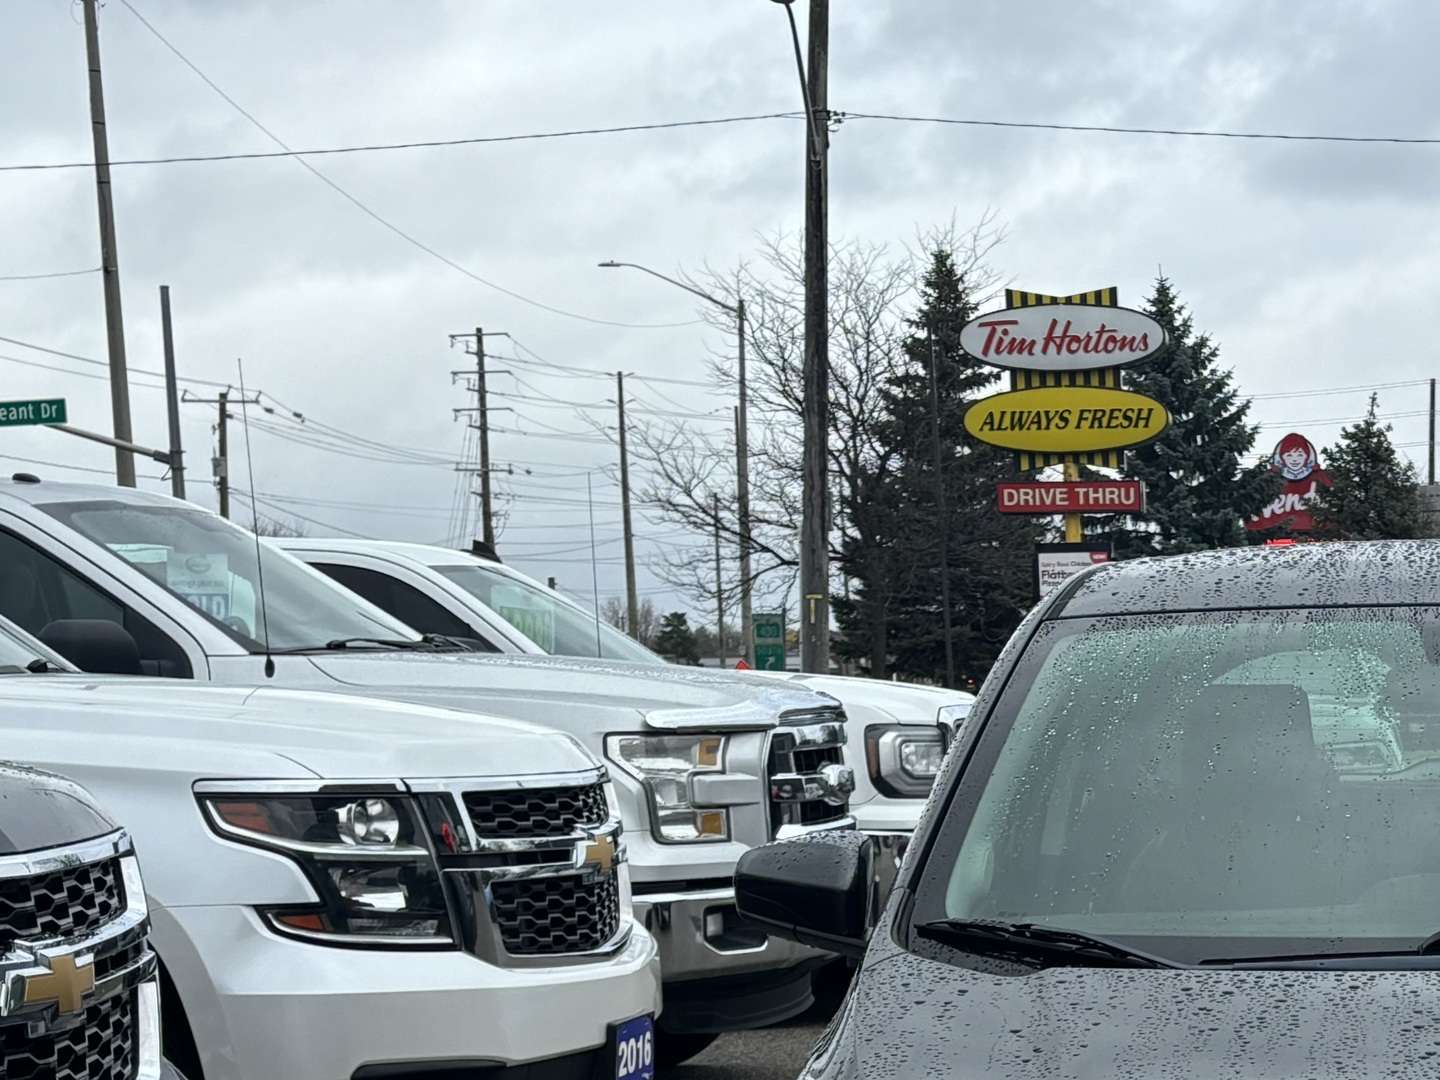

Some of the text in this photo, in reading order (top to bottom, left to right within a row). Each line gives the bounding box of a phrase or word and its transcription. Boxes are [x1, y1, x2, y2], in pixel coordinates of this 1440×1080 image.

[977, 318, 1149, 358] Tim Hortons
[41, 403, 57, 418] Dr
[978, 408, 1154, 432] ALWAYS FRESH
[1003, 487, 1135, 506] DRIVE THRU
[618, 1030, 652, 1078] 2016
